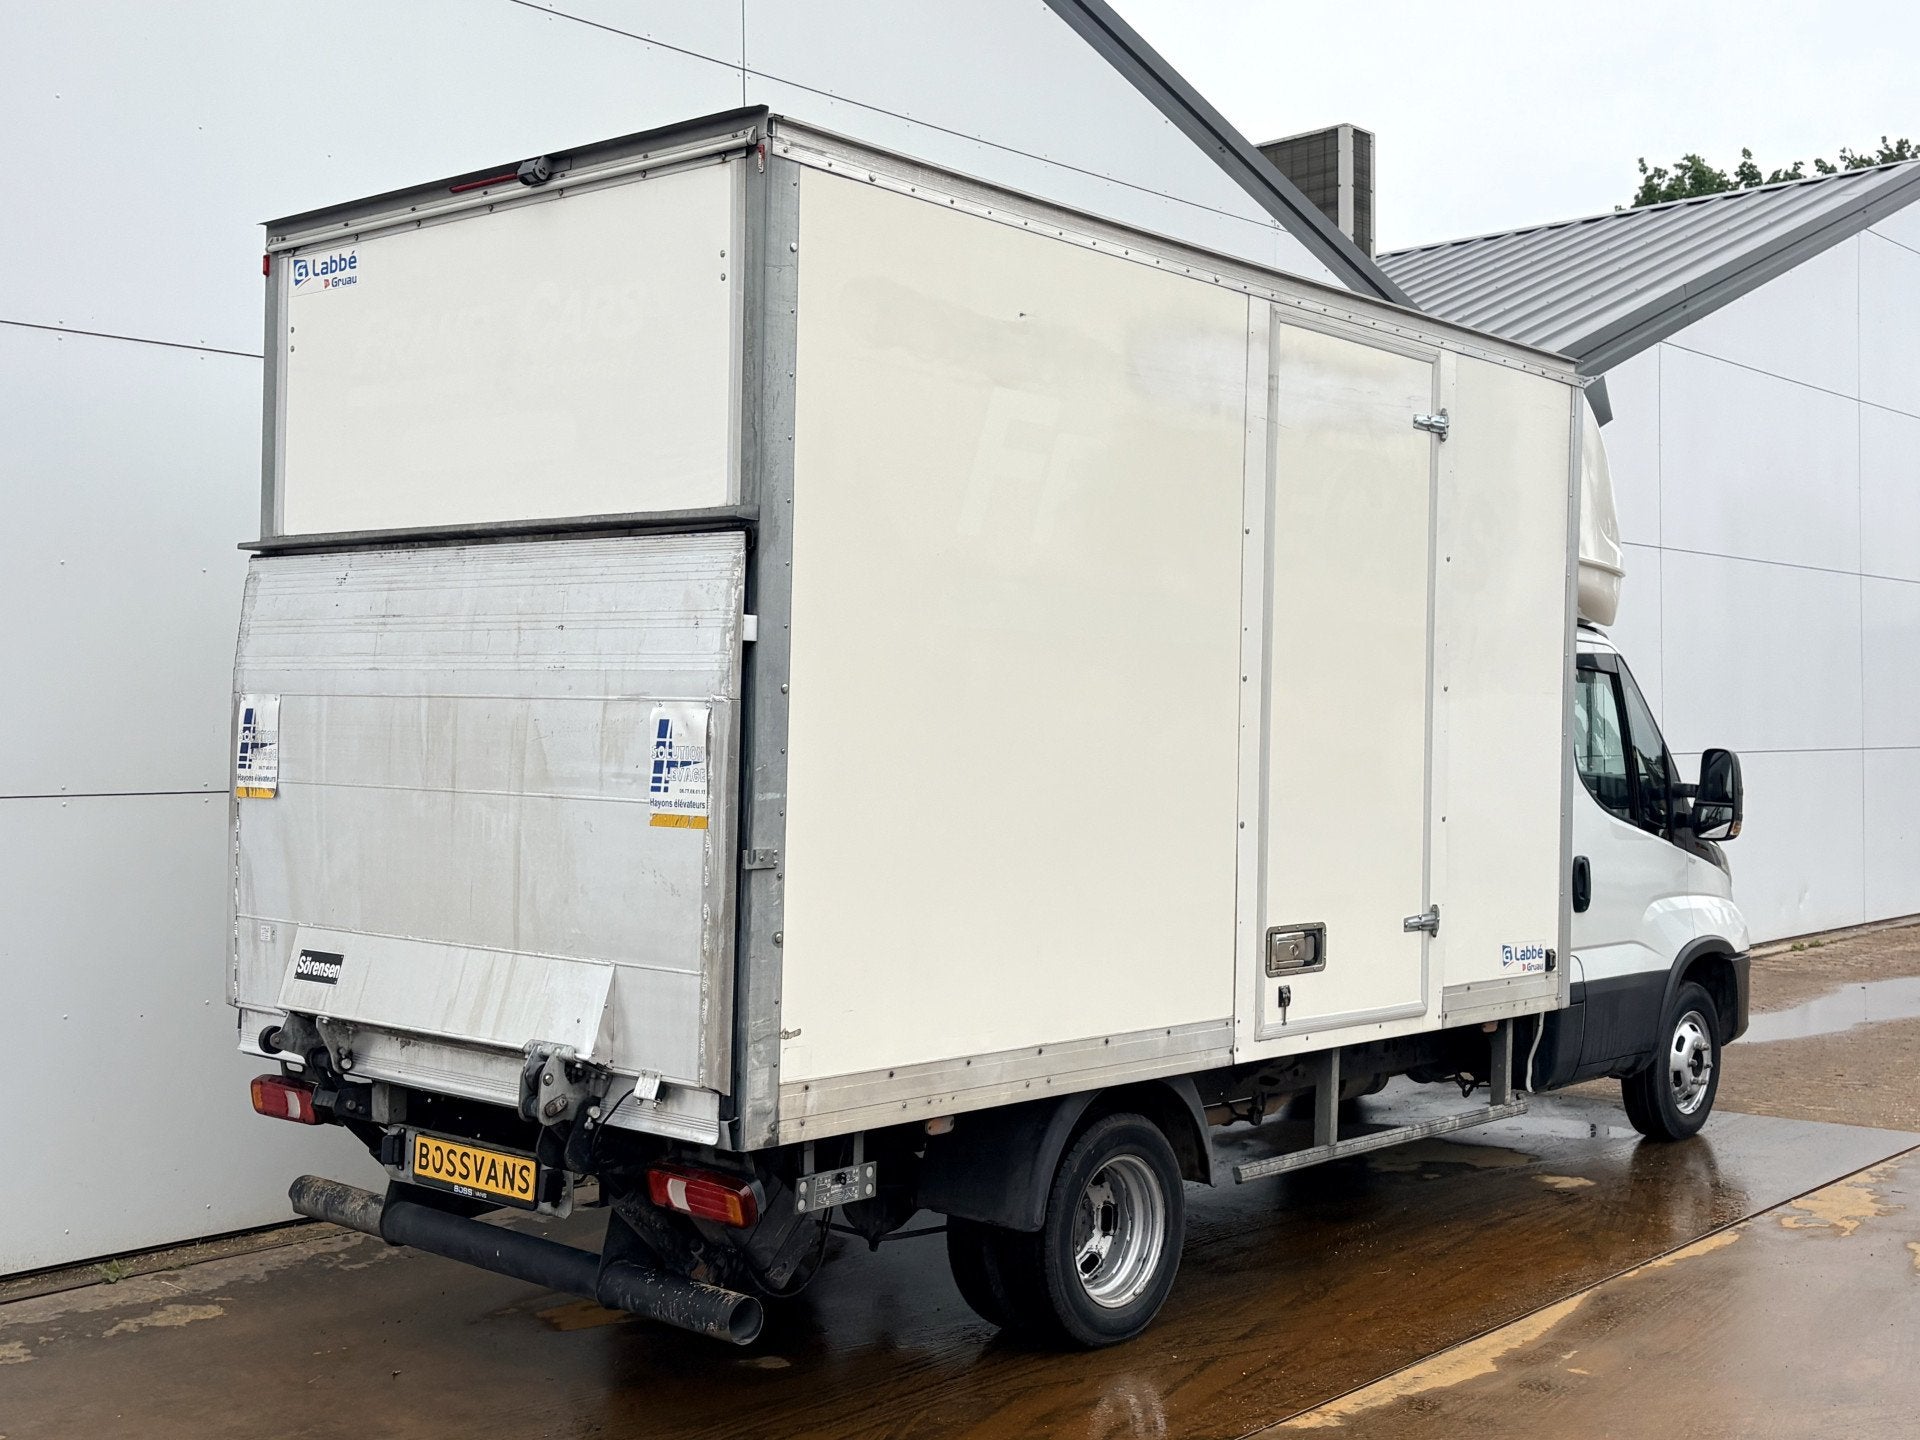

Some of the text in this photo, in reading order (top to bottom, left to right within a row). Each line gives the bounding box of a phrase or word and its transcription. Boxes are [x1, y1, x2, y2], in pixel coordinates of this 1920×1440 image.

[312, 250, 357, 277] Labbé
[331, 275, 357, 288] Gruau
[650, 745, 705, 760] SOLUTION
[665, 767, 706, 782] LEVAGE
[650, 798, 706, 809] Hayons élévateurs
[1514, 944, 1544, 962] Labbé
[297, 955, 340, 979] Sörensen
[418, 1142, 531, 1194] BOSSVANS
